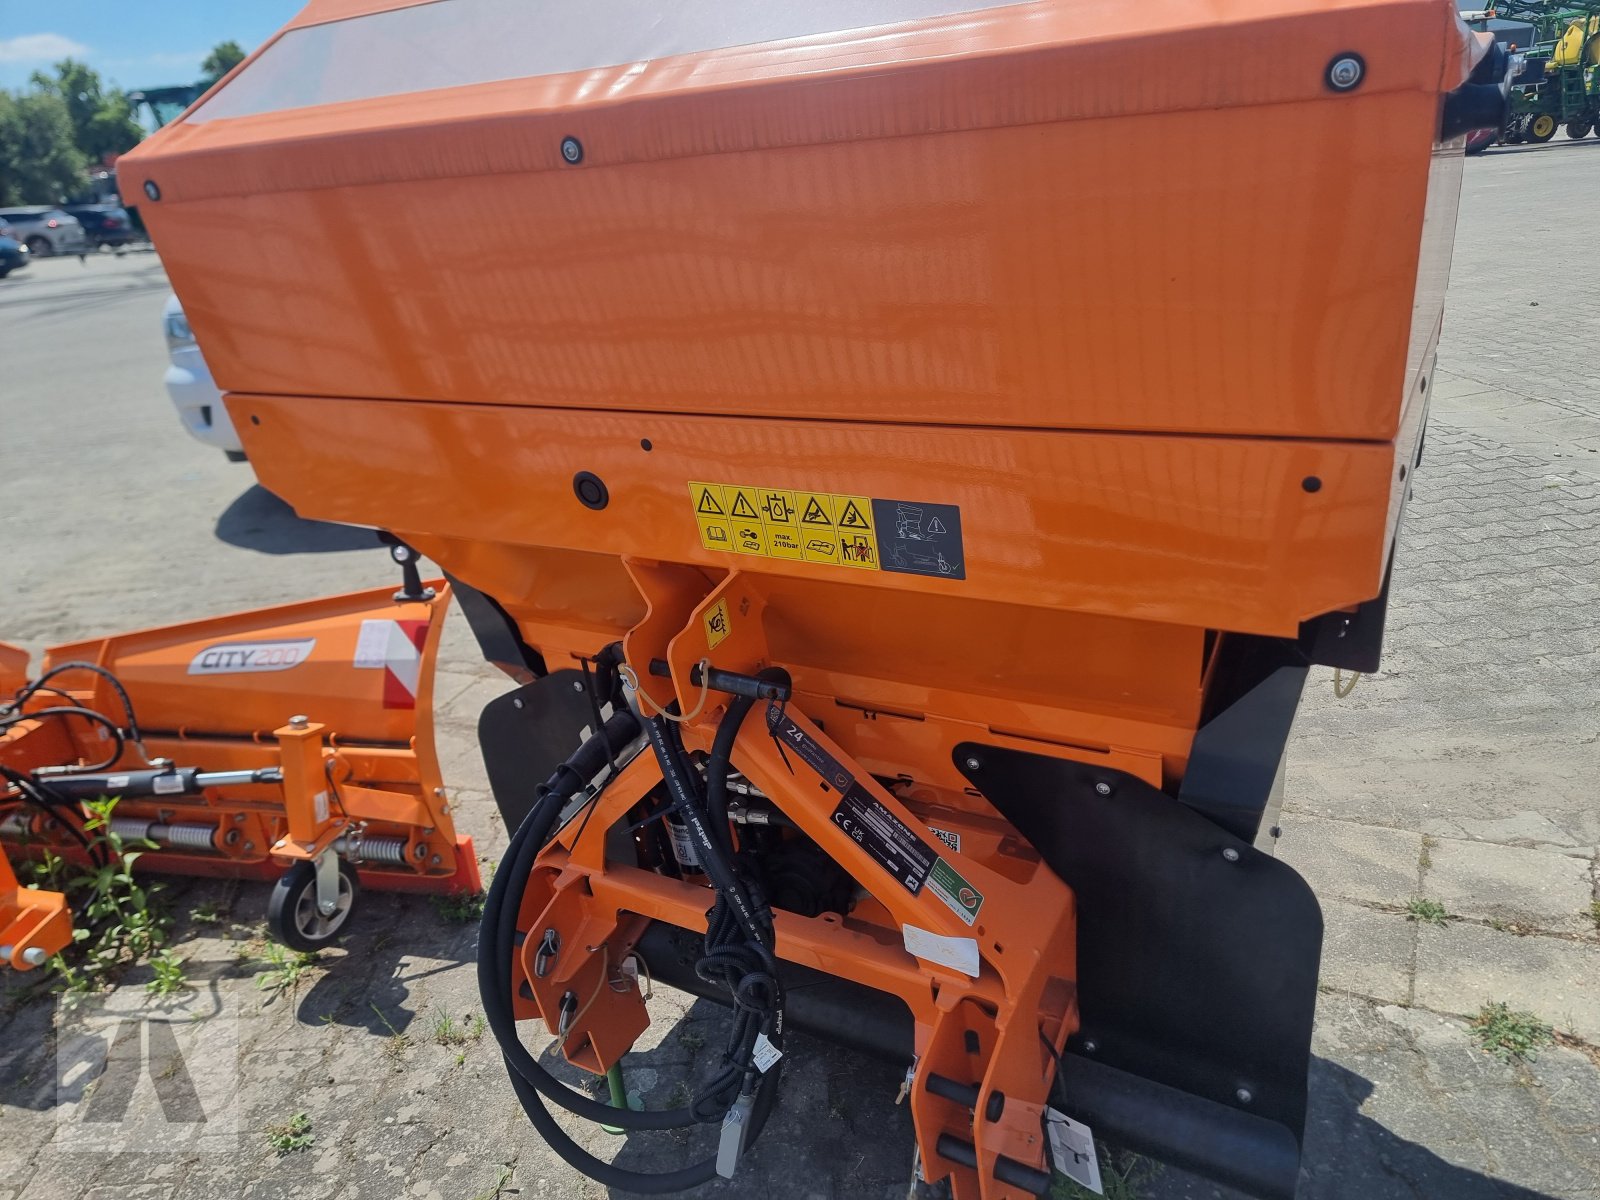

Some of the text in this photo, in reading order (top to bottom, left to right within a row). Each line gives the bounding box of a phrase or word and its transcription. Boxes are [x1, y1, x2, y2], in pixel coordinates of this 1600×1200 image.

[786, 725, 804, 742] 24
[835, 812, 852, 830] CE
[872, 802, 917, 842] AMAZONE
